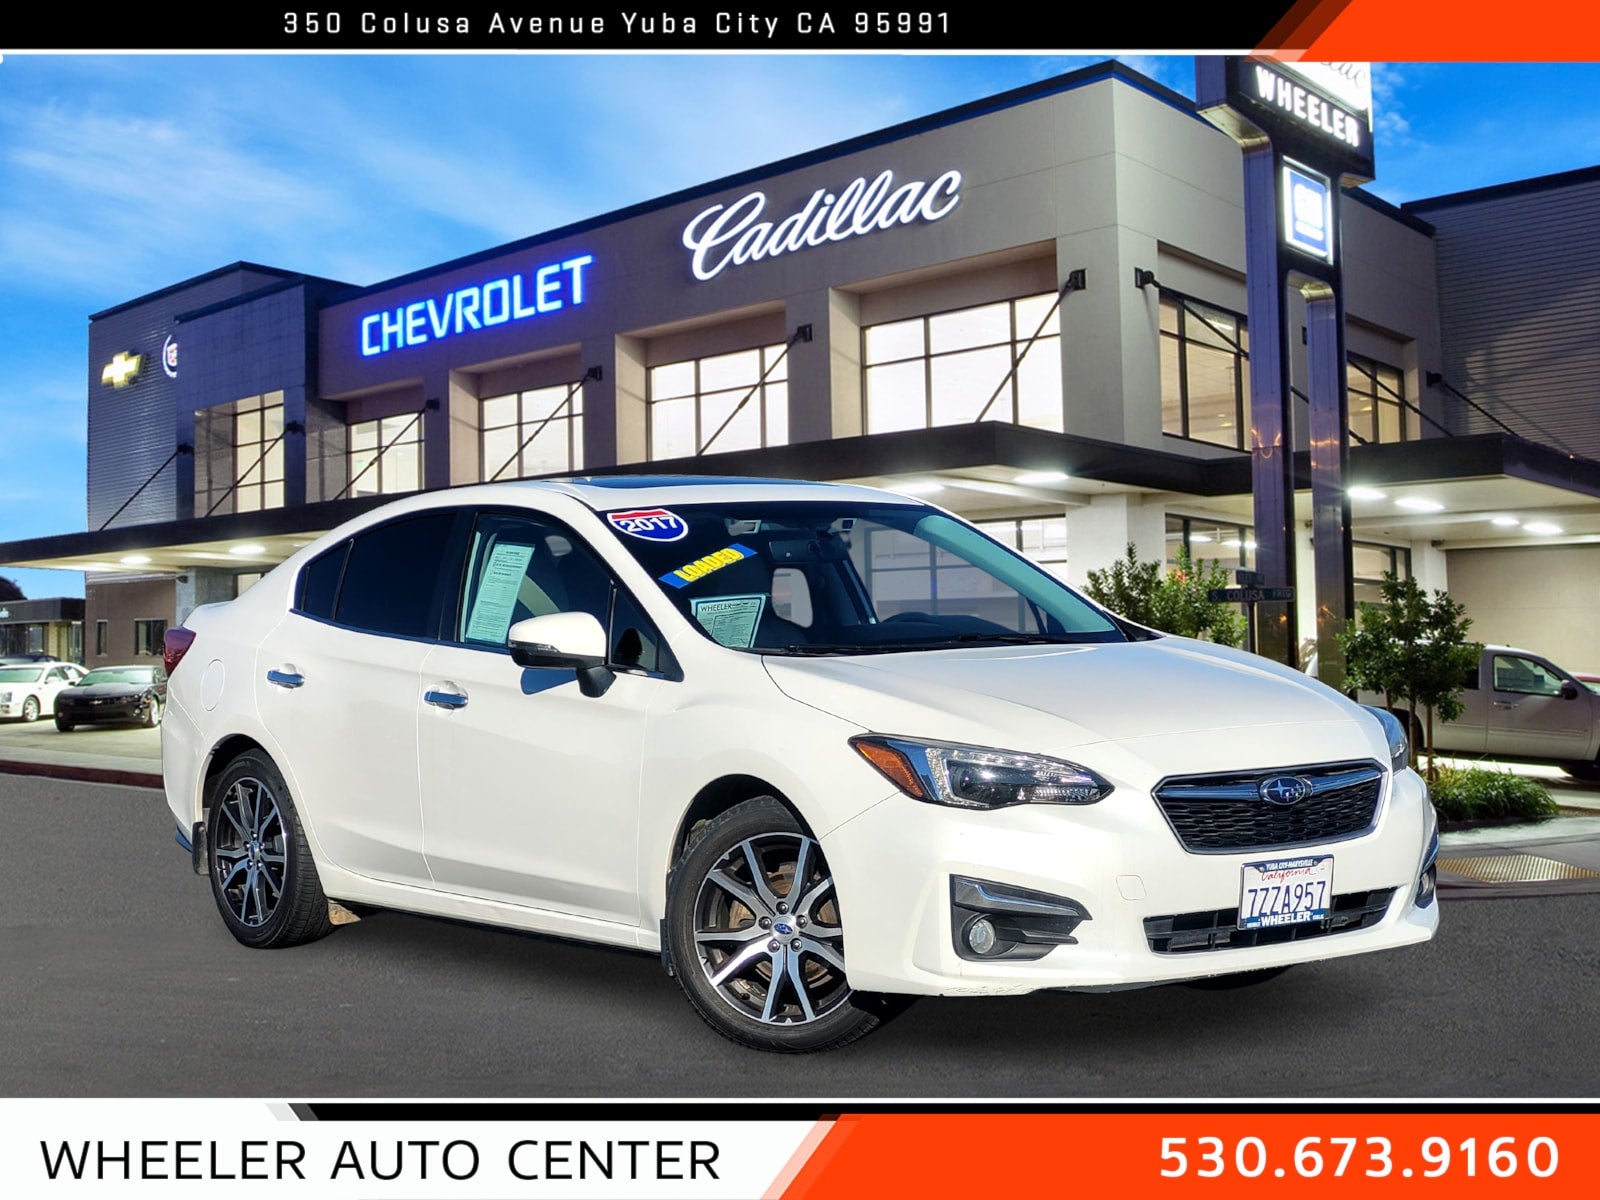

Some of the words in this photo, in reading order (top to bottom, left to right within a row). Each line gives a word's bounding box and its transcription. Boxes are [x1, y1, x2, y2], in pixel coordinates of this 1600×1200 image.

[1256, 65, 1360, 147] WHEELER
[683, 169, 962, 281] Cadillac
[361, 255, 593, 356] CHEVROLET
[619, 515, 678, 532] 2017
[673, 547, 745, 582] LOADED
[700, 603, 732, 612] WHEELER
[1227, 590, 1264, 601] COLUSA
[1248, 881, 1326, 917] 7ZZA957
[1261, 911, 1311, 927] WHEELER
